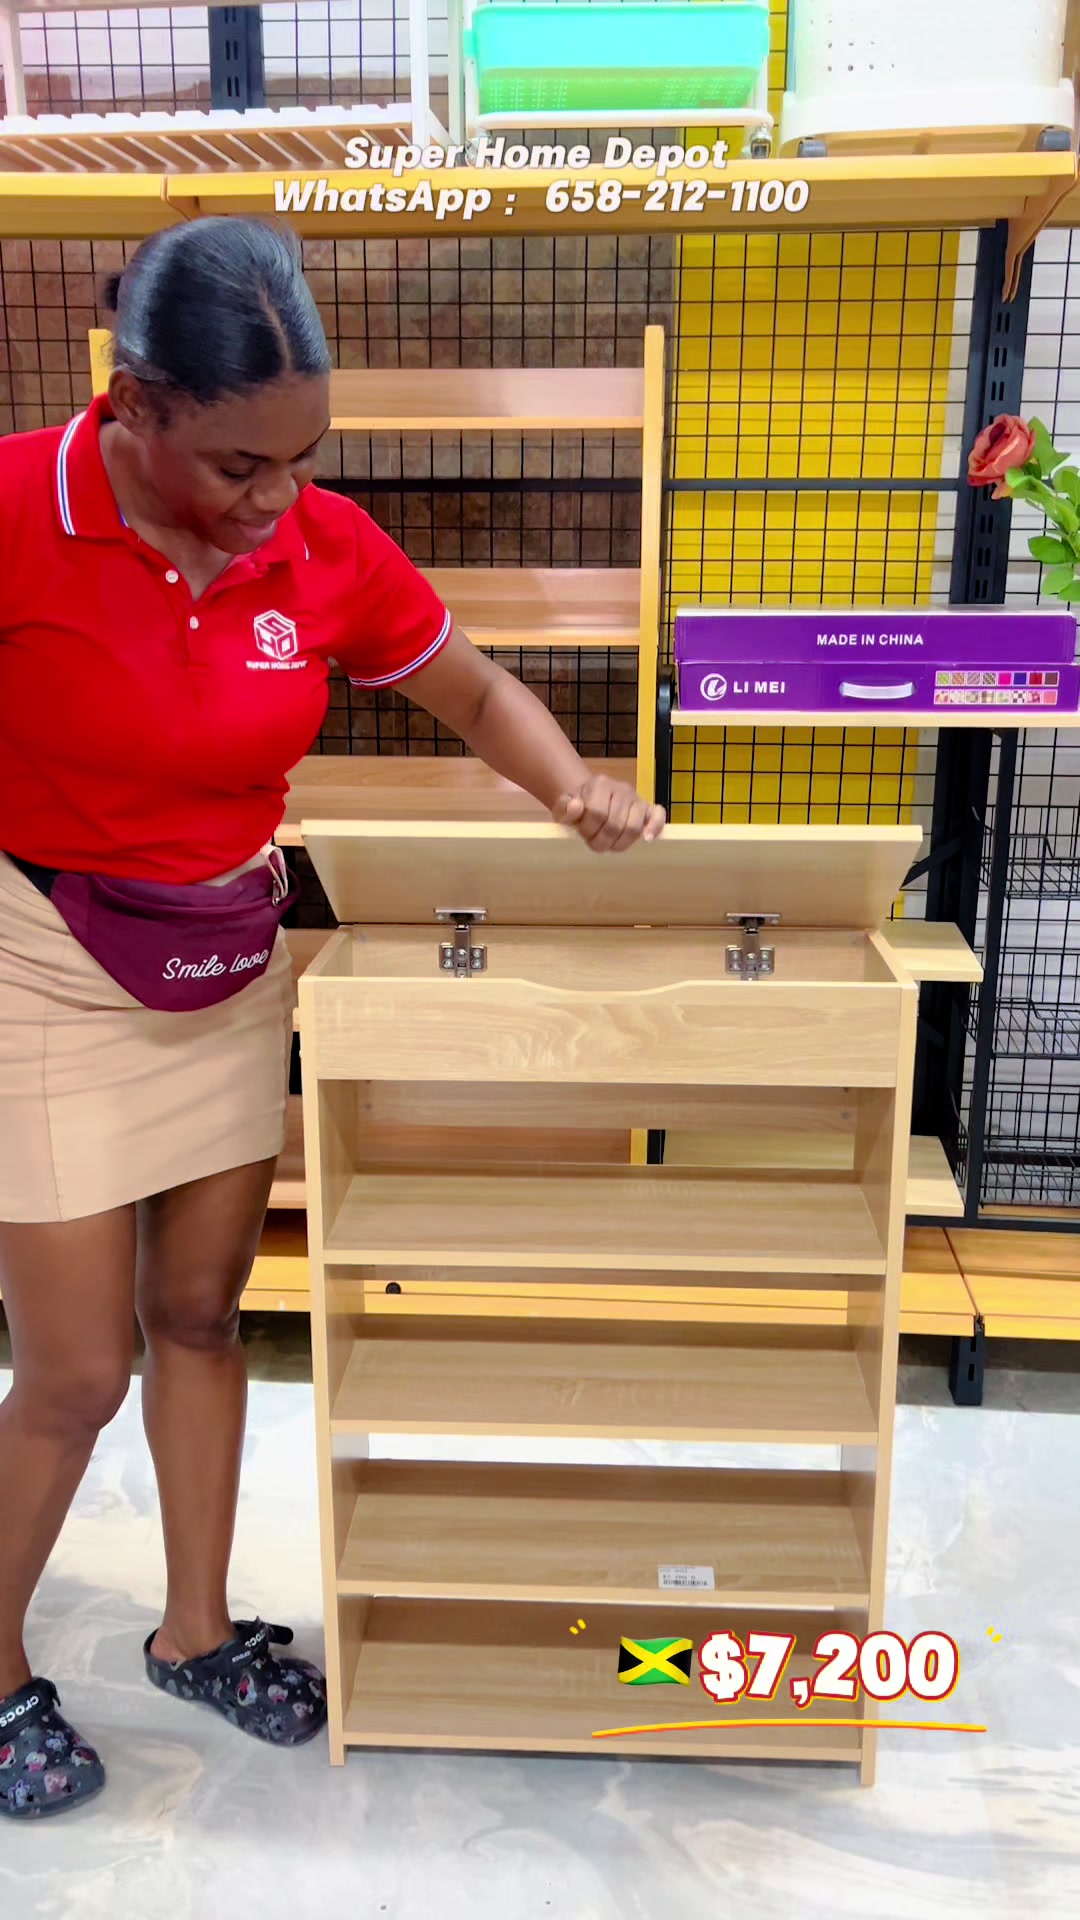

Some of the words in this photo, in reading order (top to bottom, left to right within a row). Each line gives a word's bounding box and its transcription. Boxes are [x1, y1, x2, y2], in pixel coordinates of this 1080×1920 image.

[817, 634, 858, 646] MADE
[861, 634, 875, 646] IN
[879, 633, 924, 646] CHINA
[733, 681, 749, 694] LI
[754, 681, 785, 694] MEI
[162, 954, 227, 980] Smile
[229, 949, 269, 973] Love
[0, 1695, 40, 1728] crocs
